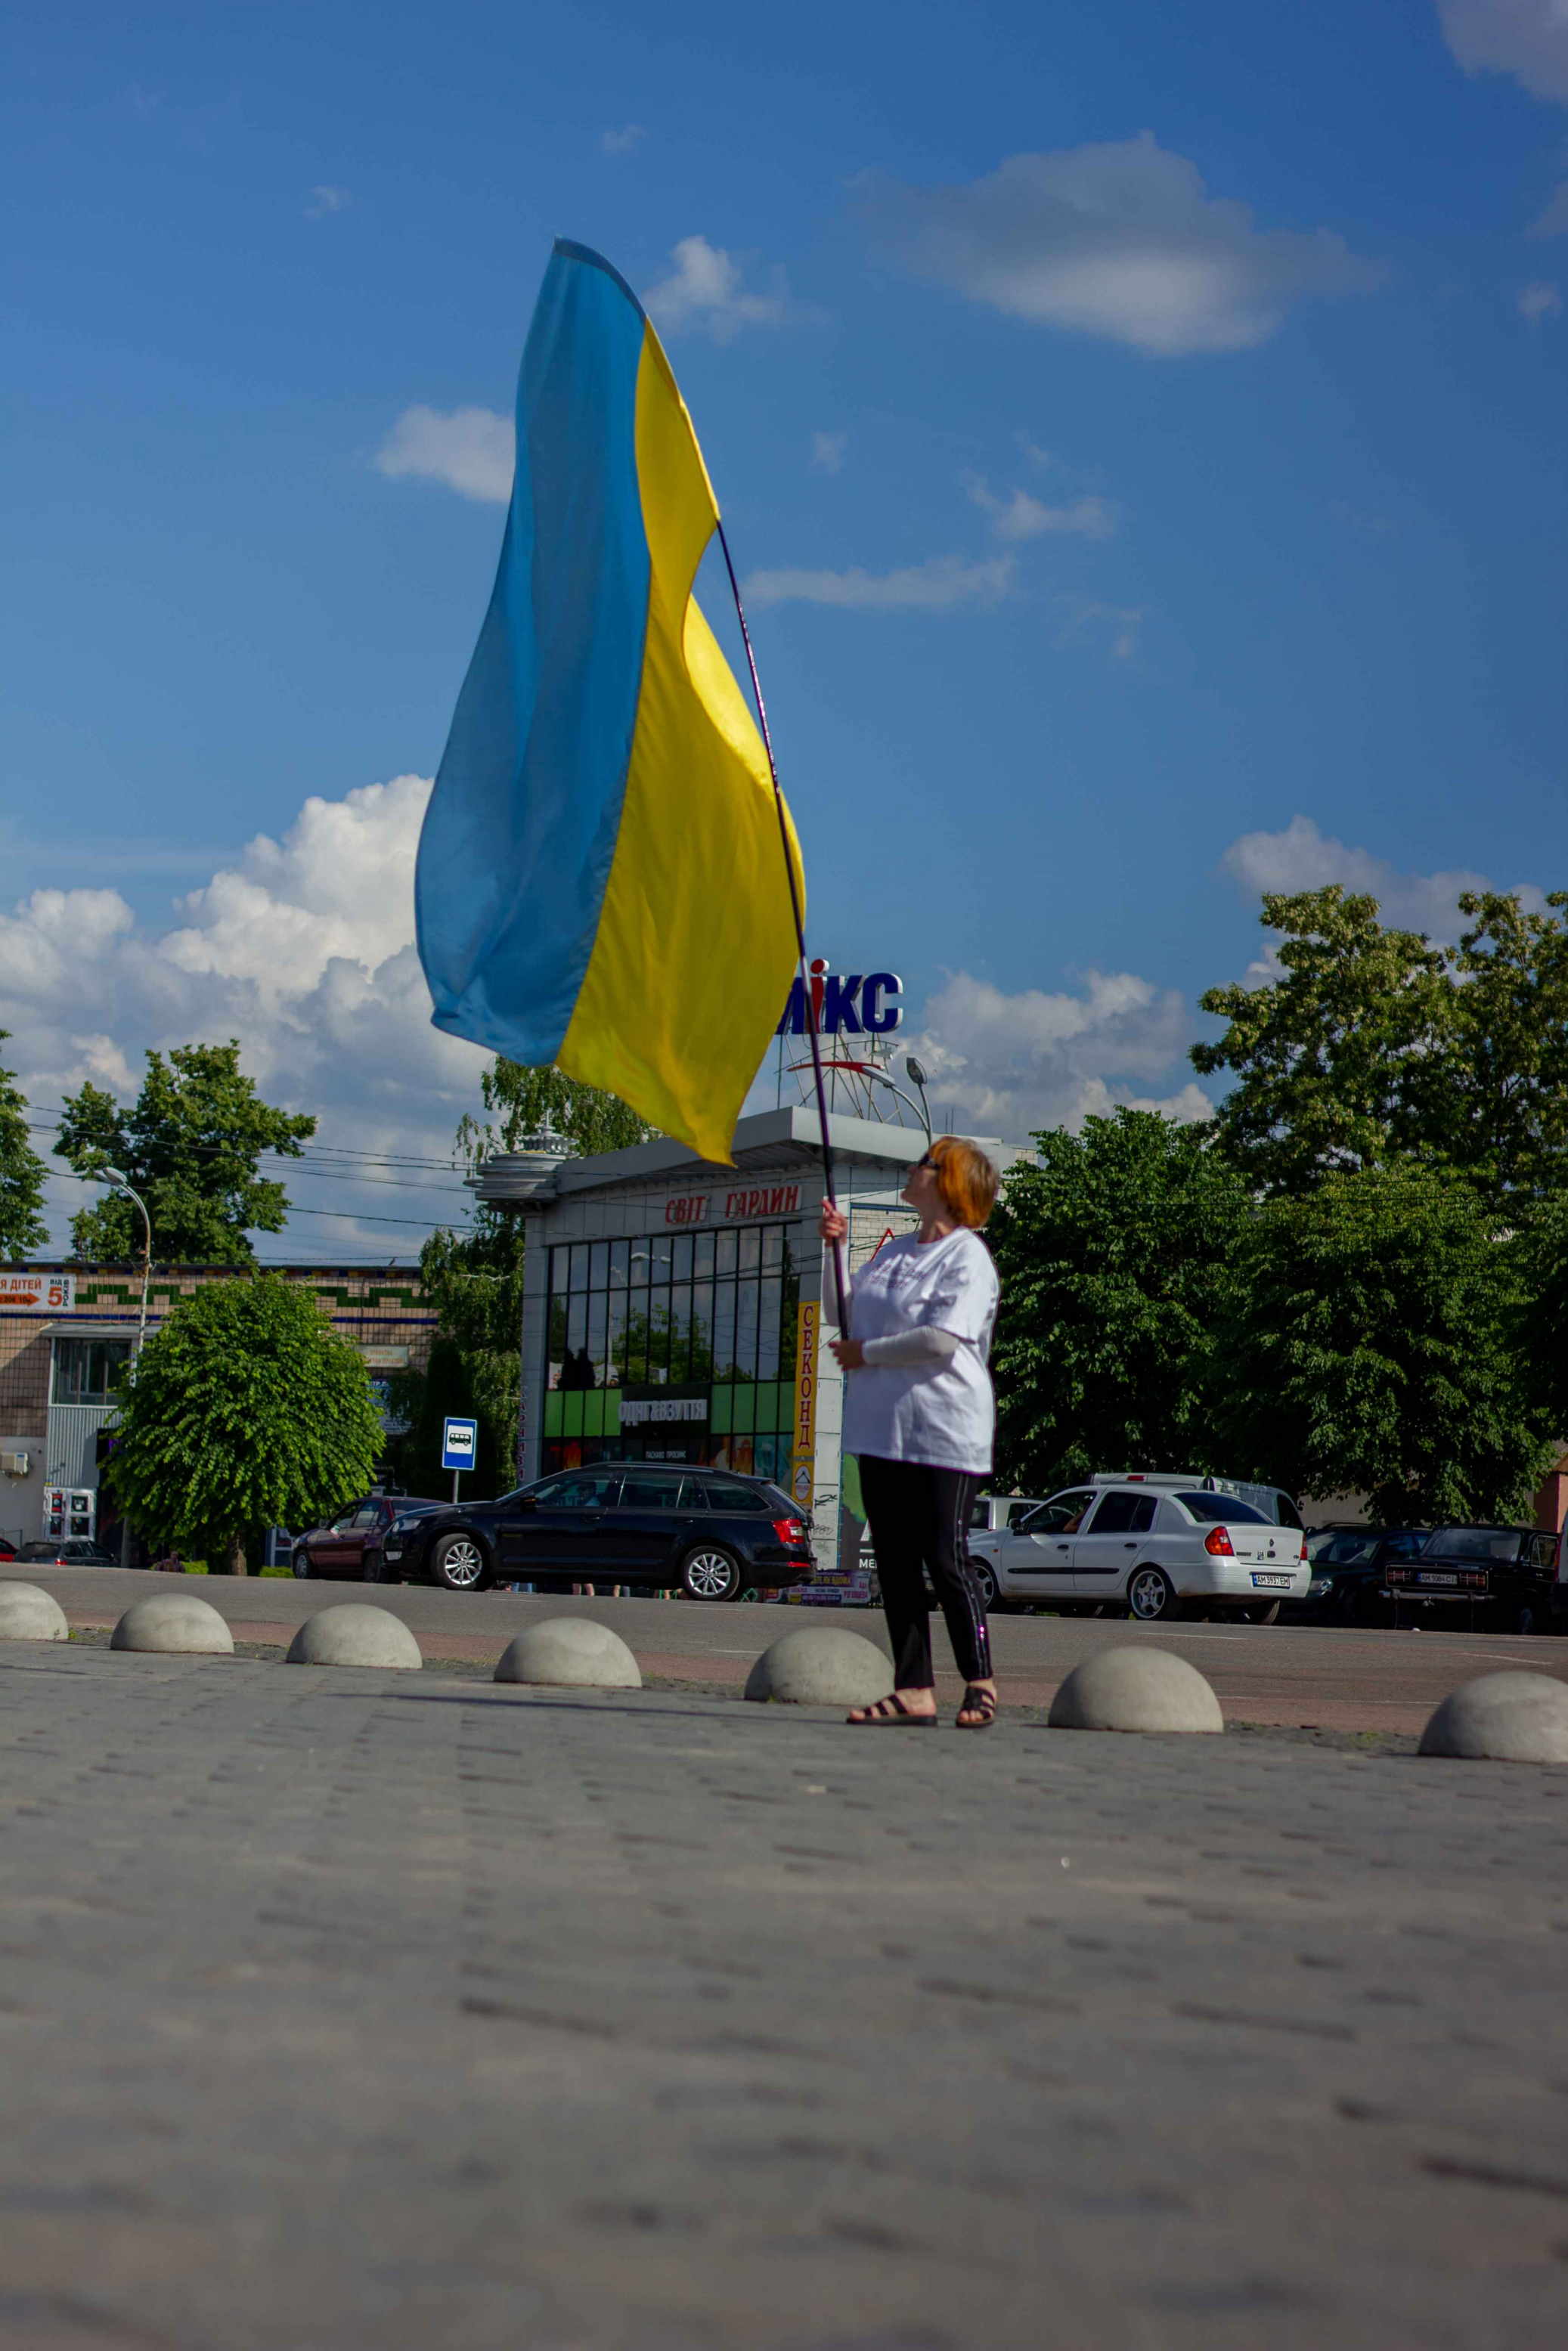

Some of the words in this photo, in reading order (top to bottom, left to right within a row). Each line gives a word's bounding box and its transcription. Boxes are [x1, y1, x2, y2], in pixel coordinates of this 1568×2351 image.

[665, 1195, 707, 1224] СВІТ
[726, 1185, 799, 1218] ГАРДИН
[11, 1277, 42, 1291] ДІТЕЙ
[48, 1286, 62, 1306] 5
[798, 1306, 813, 1448] СЕКОНД
[859, 1558, 878, 1569] МЕ
